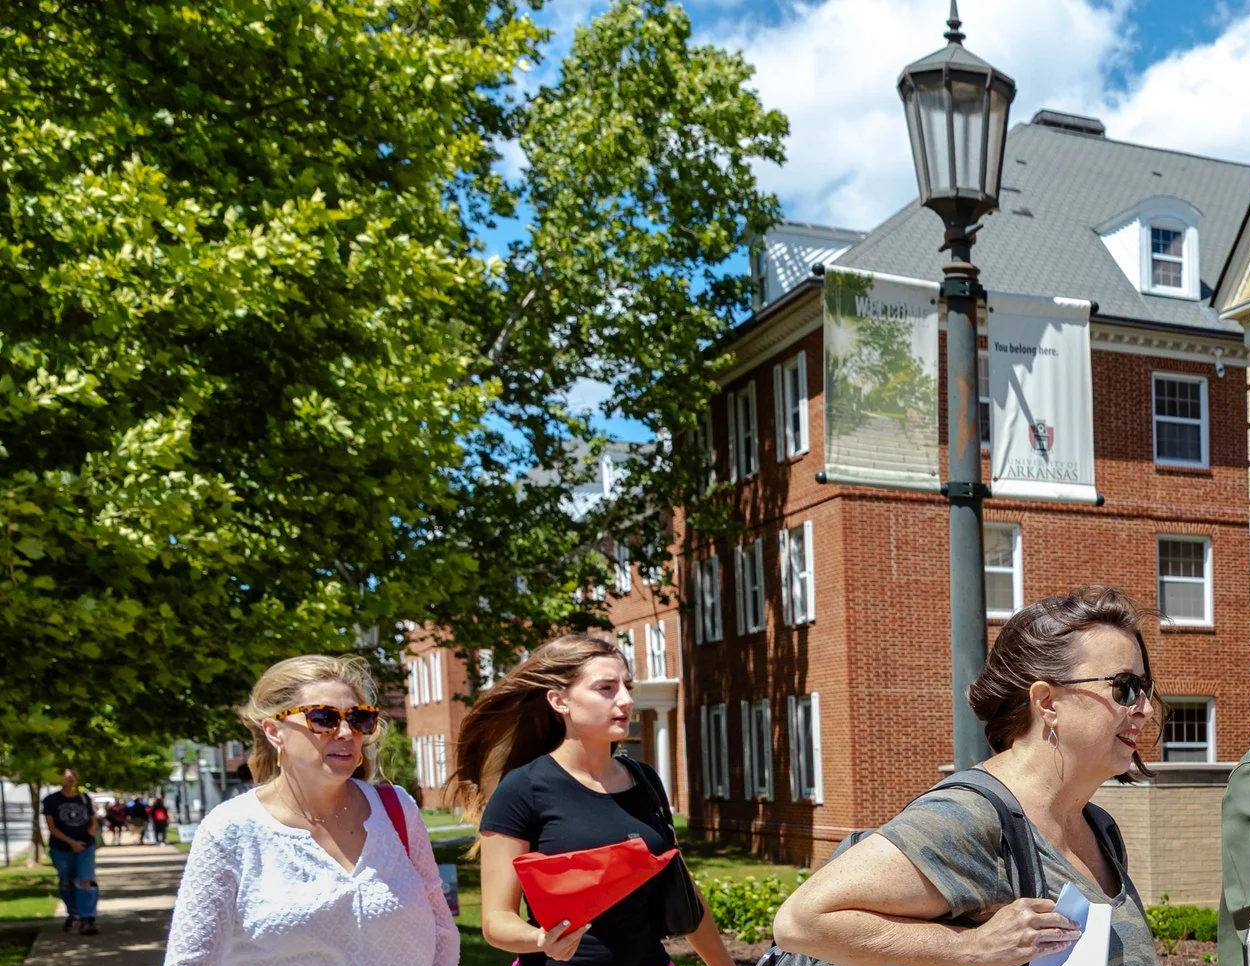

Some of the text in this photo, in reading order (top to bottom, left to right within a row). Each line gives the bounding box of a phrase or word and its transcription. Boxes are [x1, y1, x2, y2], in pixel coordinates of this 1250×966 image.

[994, 342, 1058, 358] You belong here.
[1007, 465, 1079, 481] ARKANSAS
